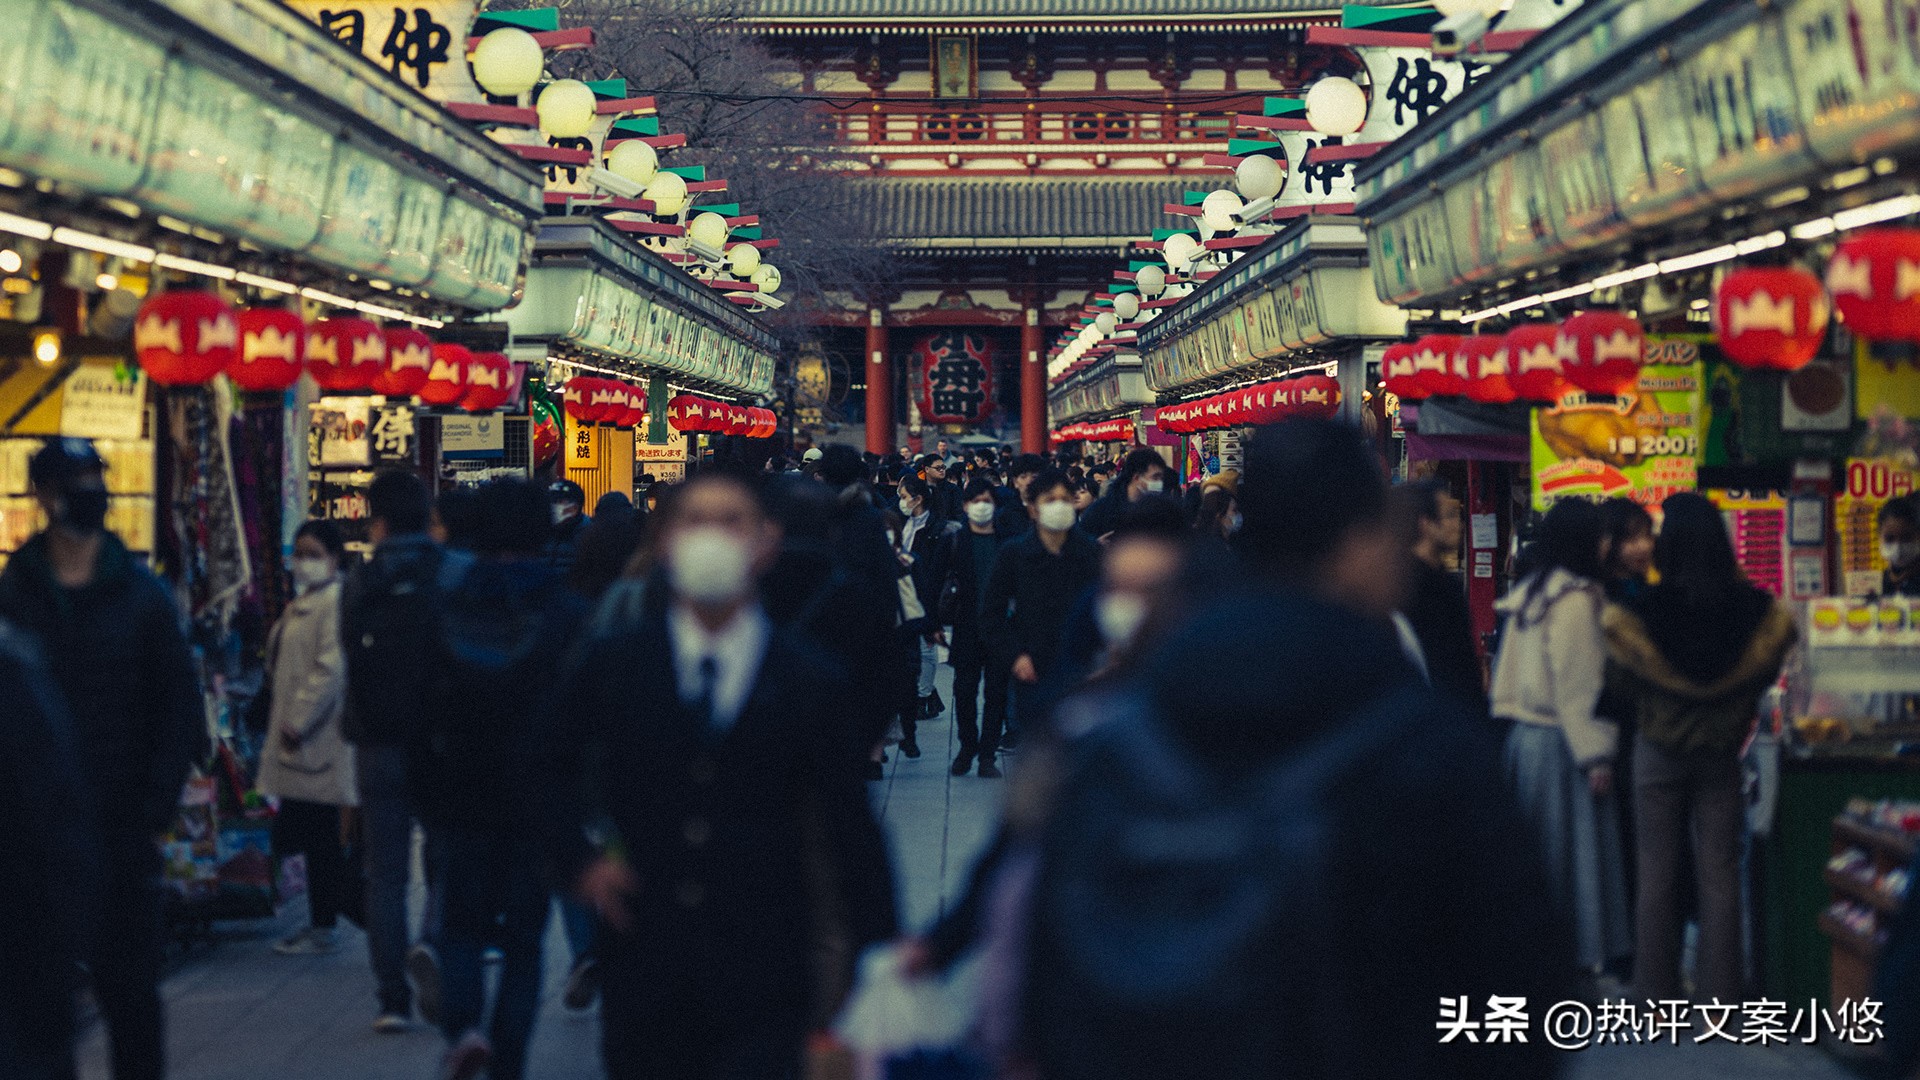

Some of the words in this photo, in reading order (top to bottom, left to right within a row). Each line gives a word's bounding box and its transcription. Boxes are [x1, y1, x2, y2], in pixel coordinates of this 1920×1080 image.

[928, 332, 987, 419] 小舟町
[1836, 461, 1913, 499] 00円
